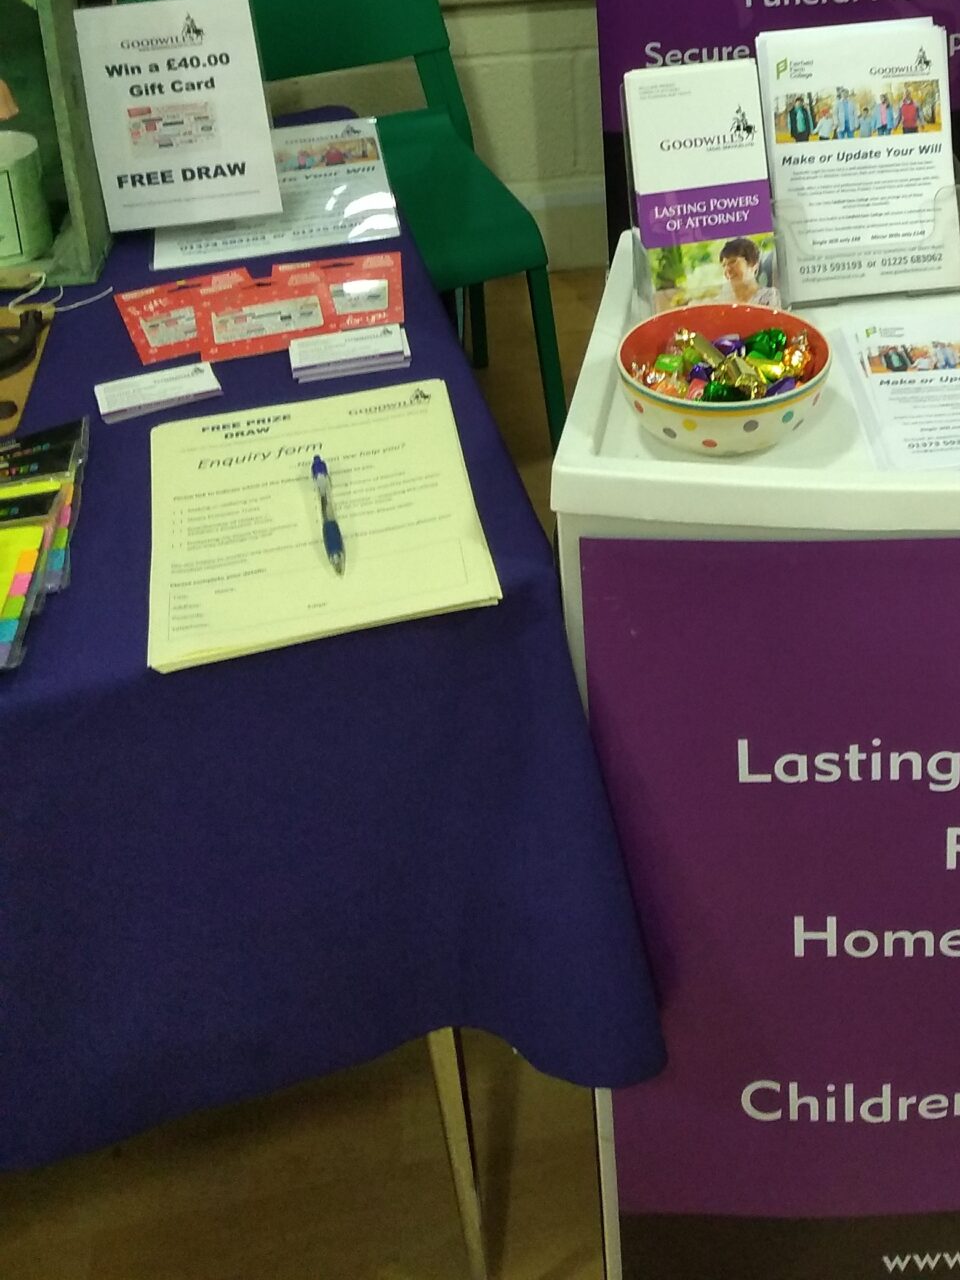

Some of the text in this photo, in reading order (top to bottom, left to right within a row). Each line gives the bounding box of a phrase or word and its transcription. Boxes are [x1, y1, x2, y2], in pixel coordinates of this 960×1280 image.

[120, 34, 196, 50] GOODWILLS
[104, 52, 230, 78] Win a £40.00
[644, 41, 750, 68] Secure
[129, 77, 216, 98] Gift Card
[660, 133, 745, 152] GOODWILLS
[782, 143, 942, 167] Make or Update Your Will
[116, 162, 247, 190] FREE DRAW
[654, 195, 759, 219] LASTING POWERS
[666, 210, 750, 232] OF ATTORNEY
[799, 263, 828, 275] 01373
[830, 260, 862, 272] 593193
[866, 260, 877, 268] or
[881, 256, 908, 267] 01225
[879, 377, 917, 386] Make
[201, 414, 292, 433] FREE PRIZE
[224, 427, 270, 439] DRAW
[198, 441, 323, 471] Enquiry form
